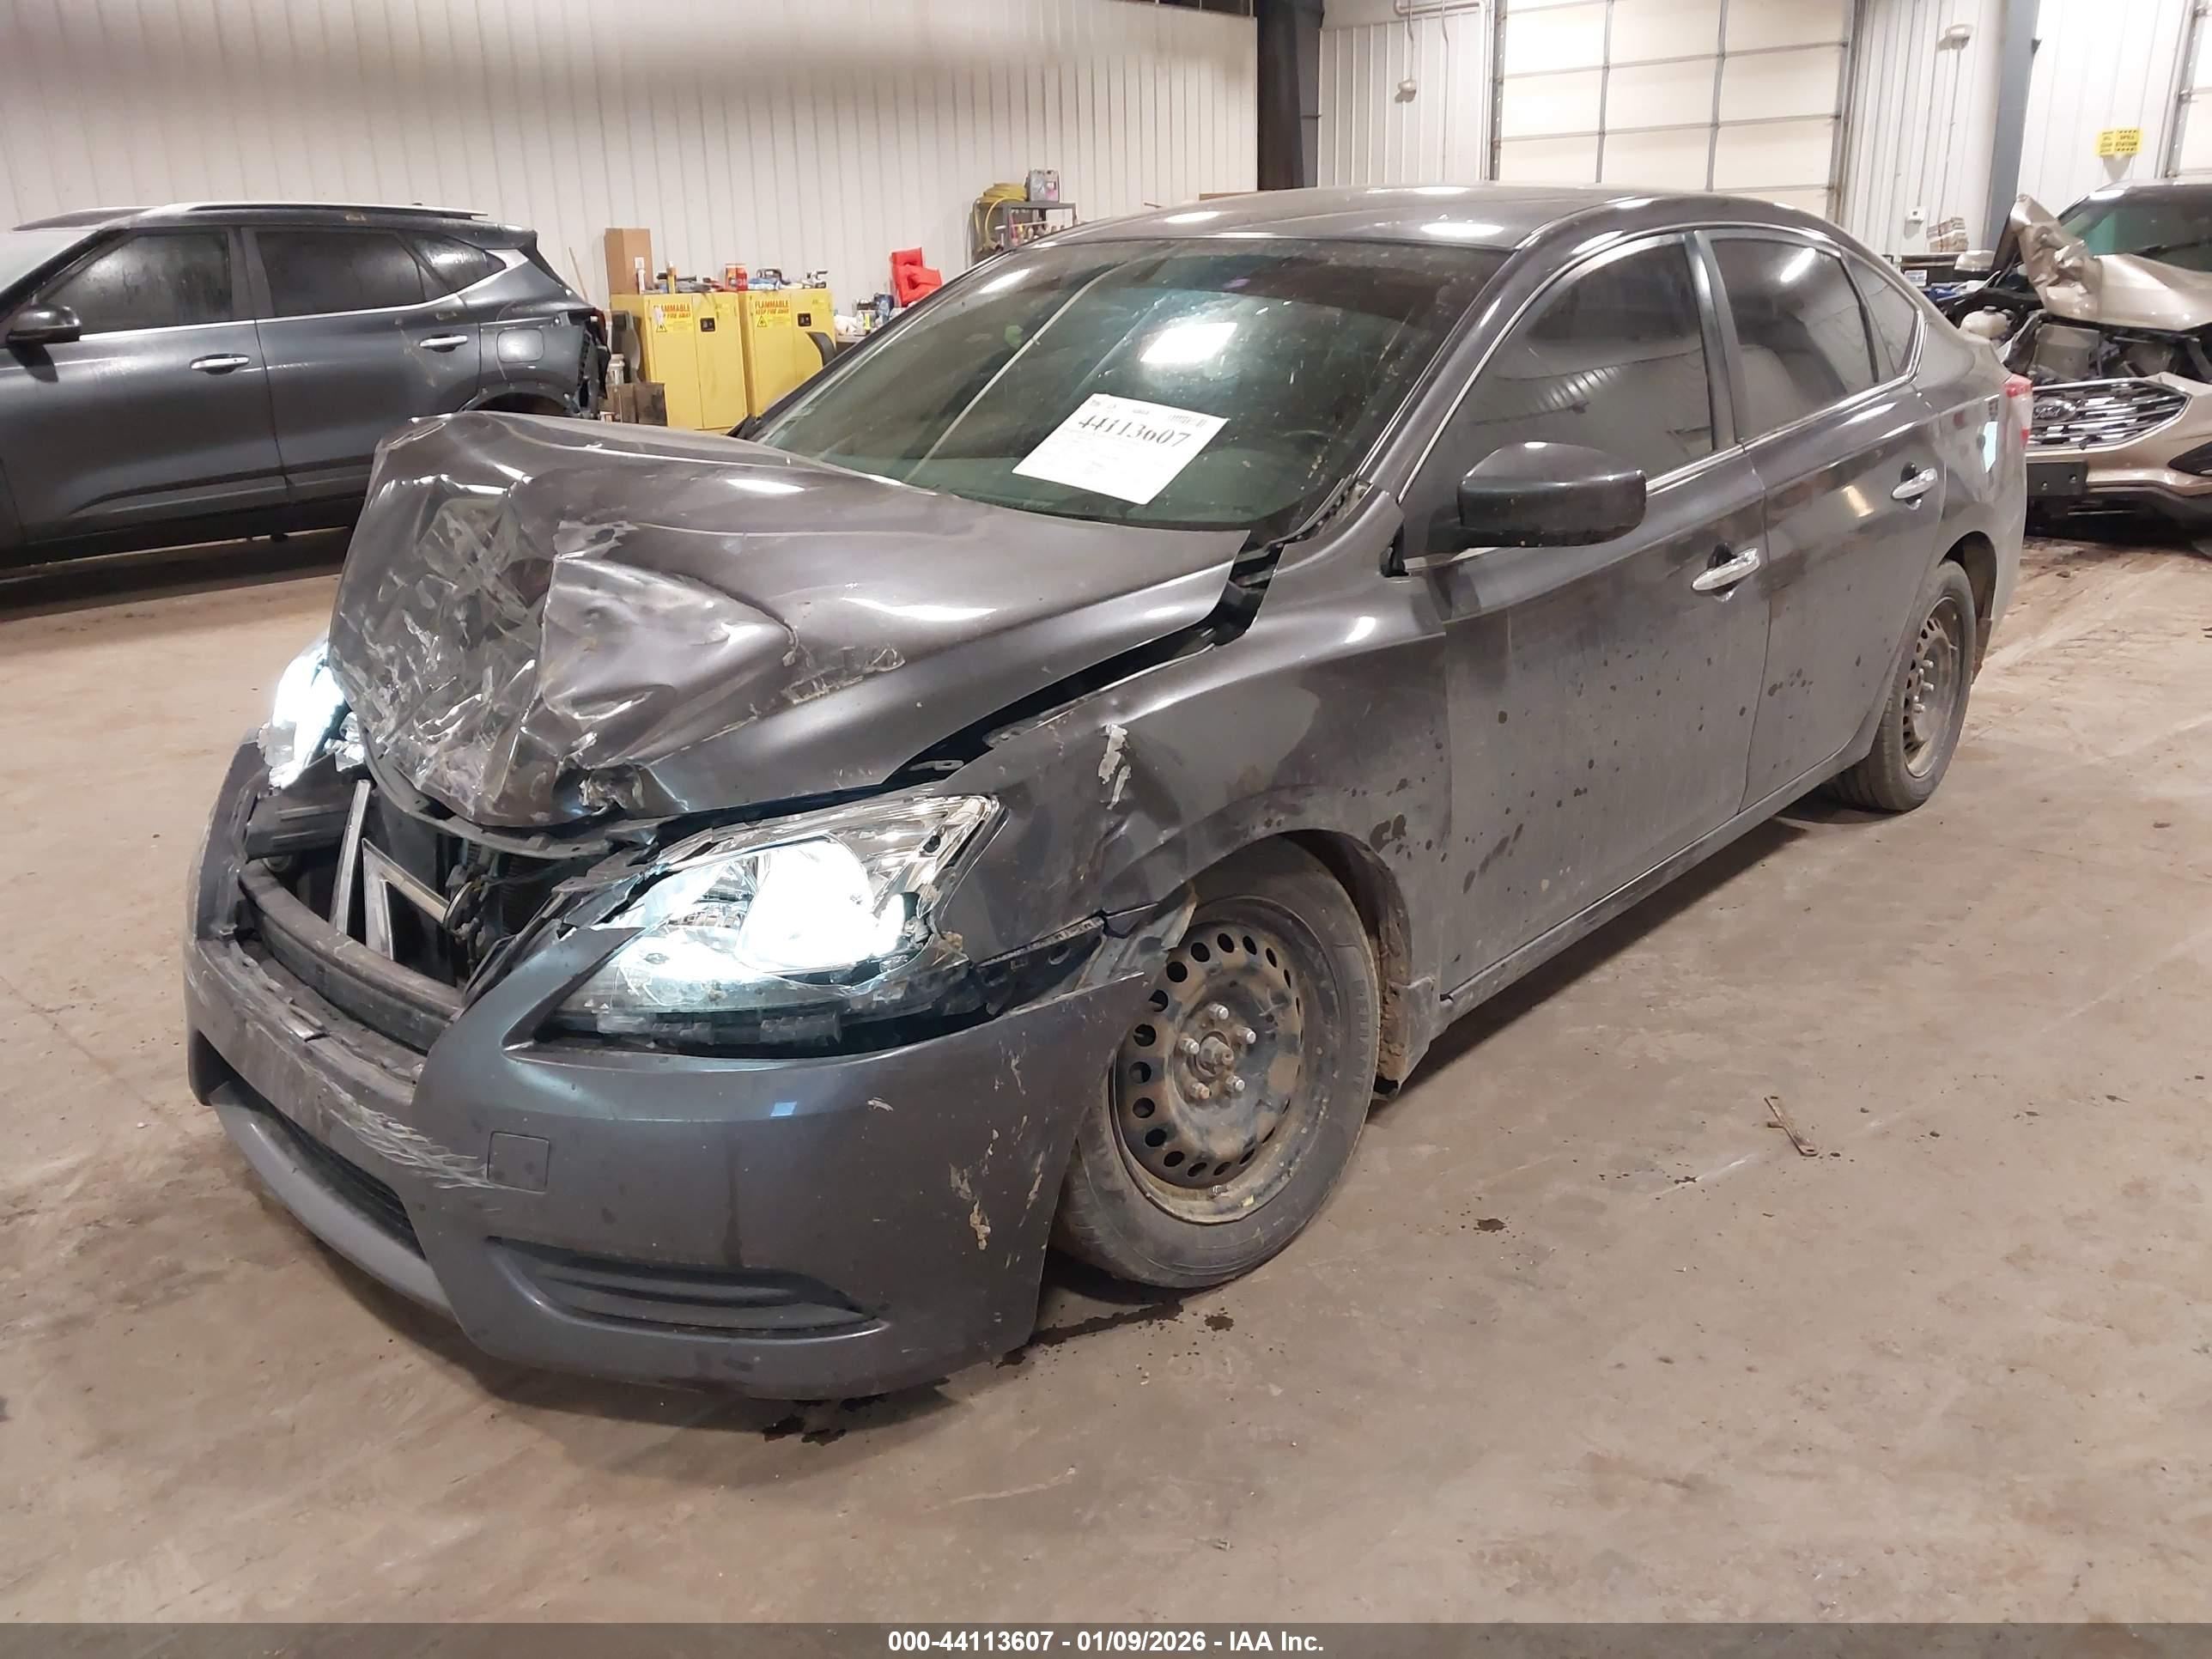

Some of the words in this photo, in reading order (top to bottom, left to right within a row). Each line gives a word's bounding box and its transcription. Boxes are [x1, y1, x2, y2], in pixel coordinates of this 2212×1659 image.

[653, 303, 690, 313] AMMABLE
[755, 300, 789, 309] FLAMMABLE
[1078, 415, 1192, 447] 44113607
